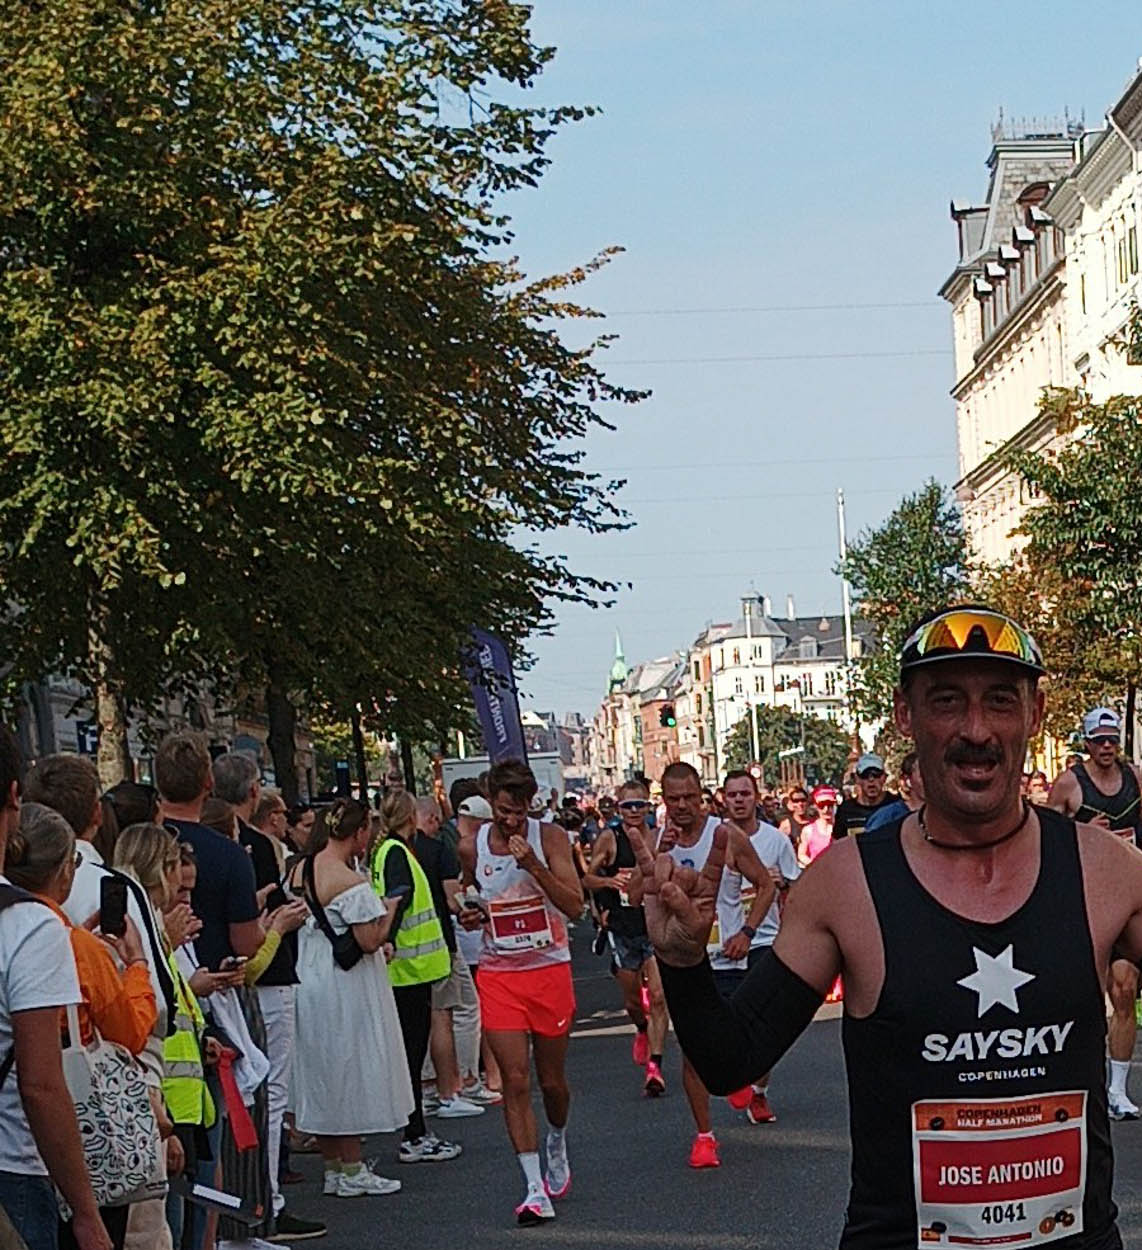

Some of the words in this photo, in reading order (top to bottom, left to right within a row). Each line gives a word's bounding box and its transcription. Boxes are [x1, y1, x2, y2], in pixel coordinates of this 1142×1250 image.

[921, 1020, 1075, 1062] SAYSKY
[957, 1066, 1047, 1083] COPENHAGEN
[957, 1117, 984, 1128] HALF
[985, 1113, 1043, 1127] MARATHON
[938, 1166, 983, 1187] JOSE
[986, 1156, 1065, 1185] ANTONIO
[980, 1202, 1028, 1225] 4041
